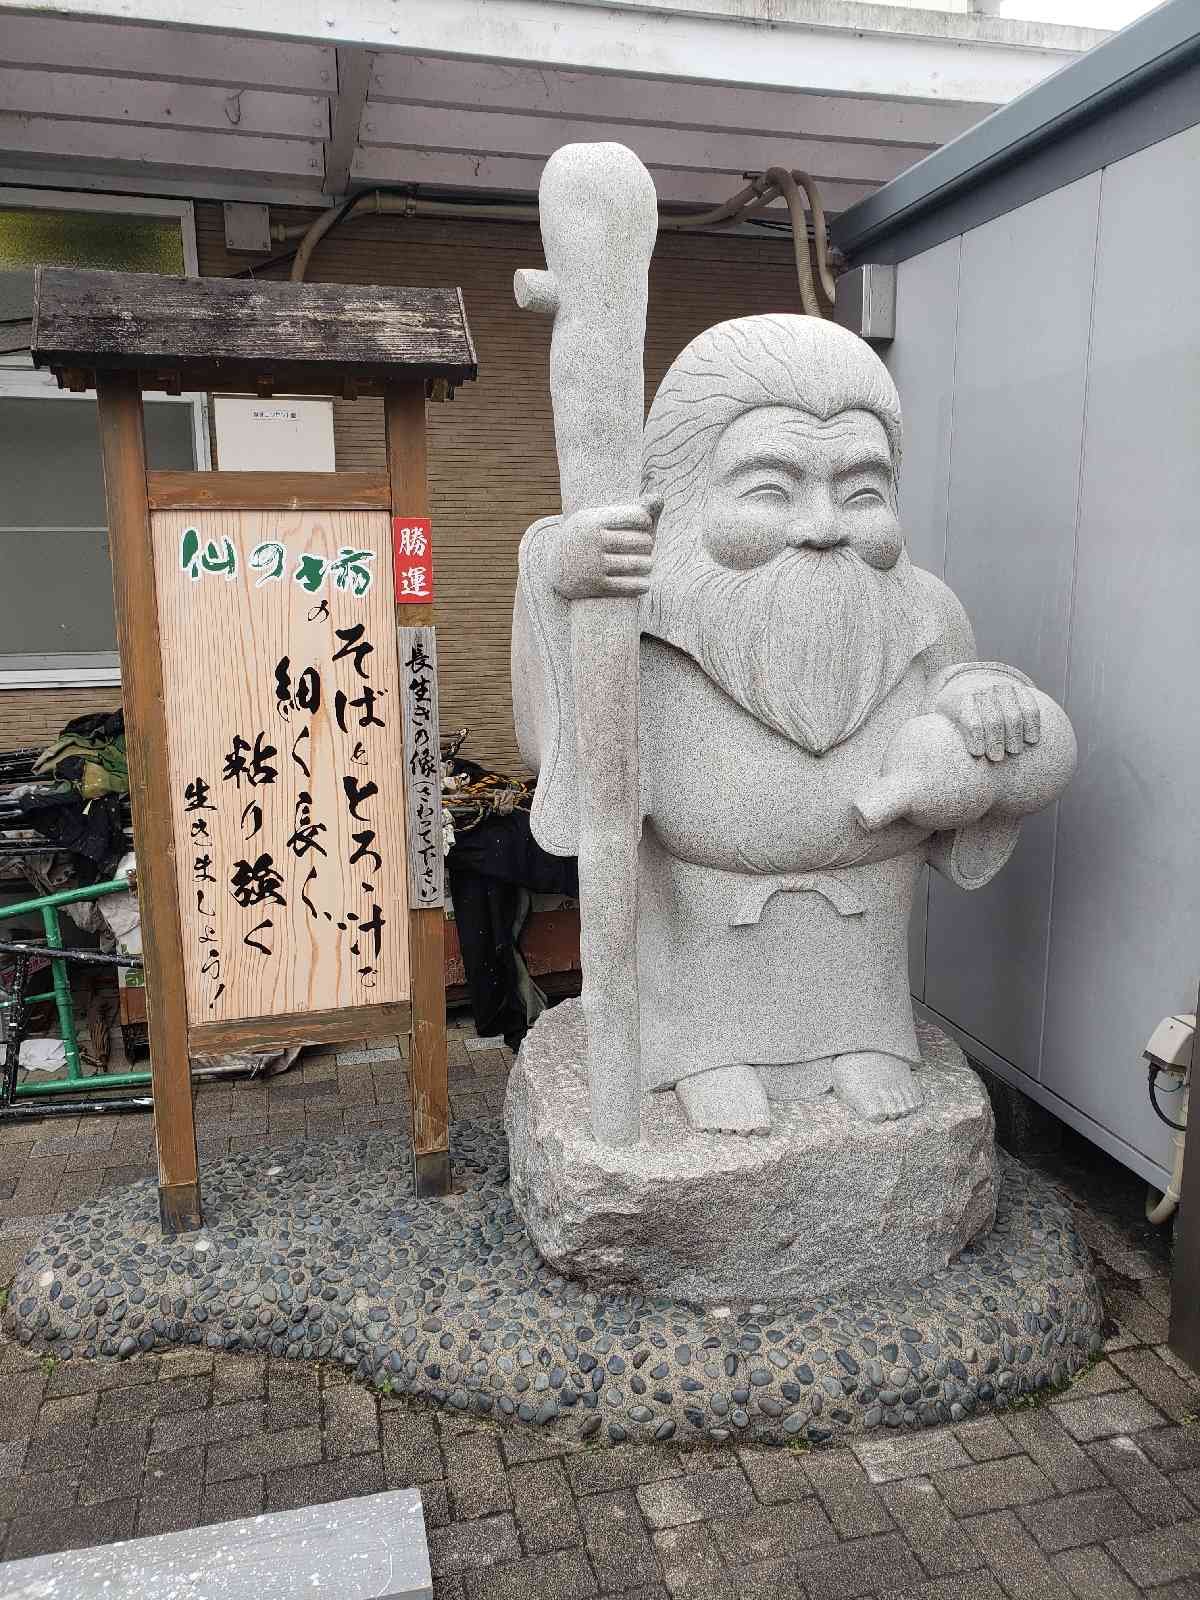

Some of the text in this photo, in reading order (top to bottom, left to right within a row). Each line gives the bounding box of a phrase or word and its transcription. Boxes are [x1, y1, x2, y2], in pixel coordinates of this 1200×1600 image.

[399, 527, 430, 597] 勝運
[222, 731, 287, 957] 粘り強く
